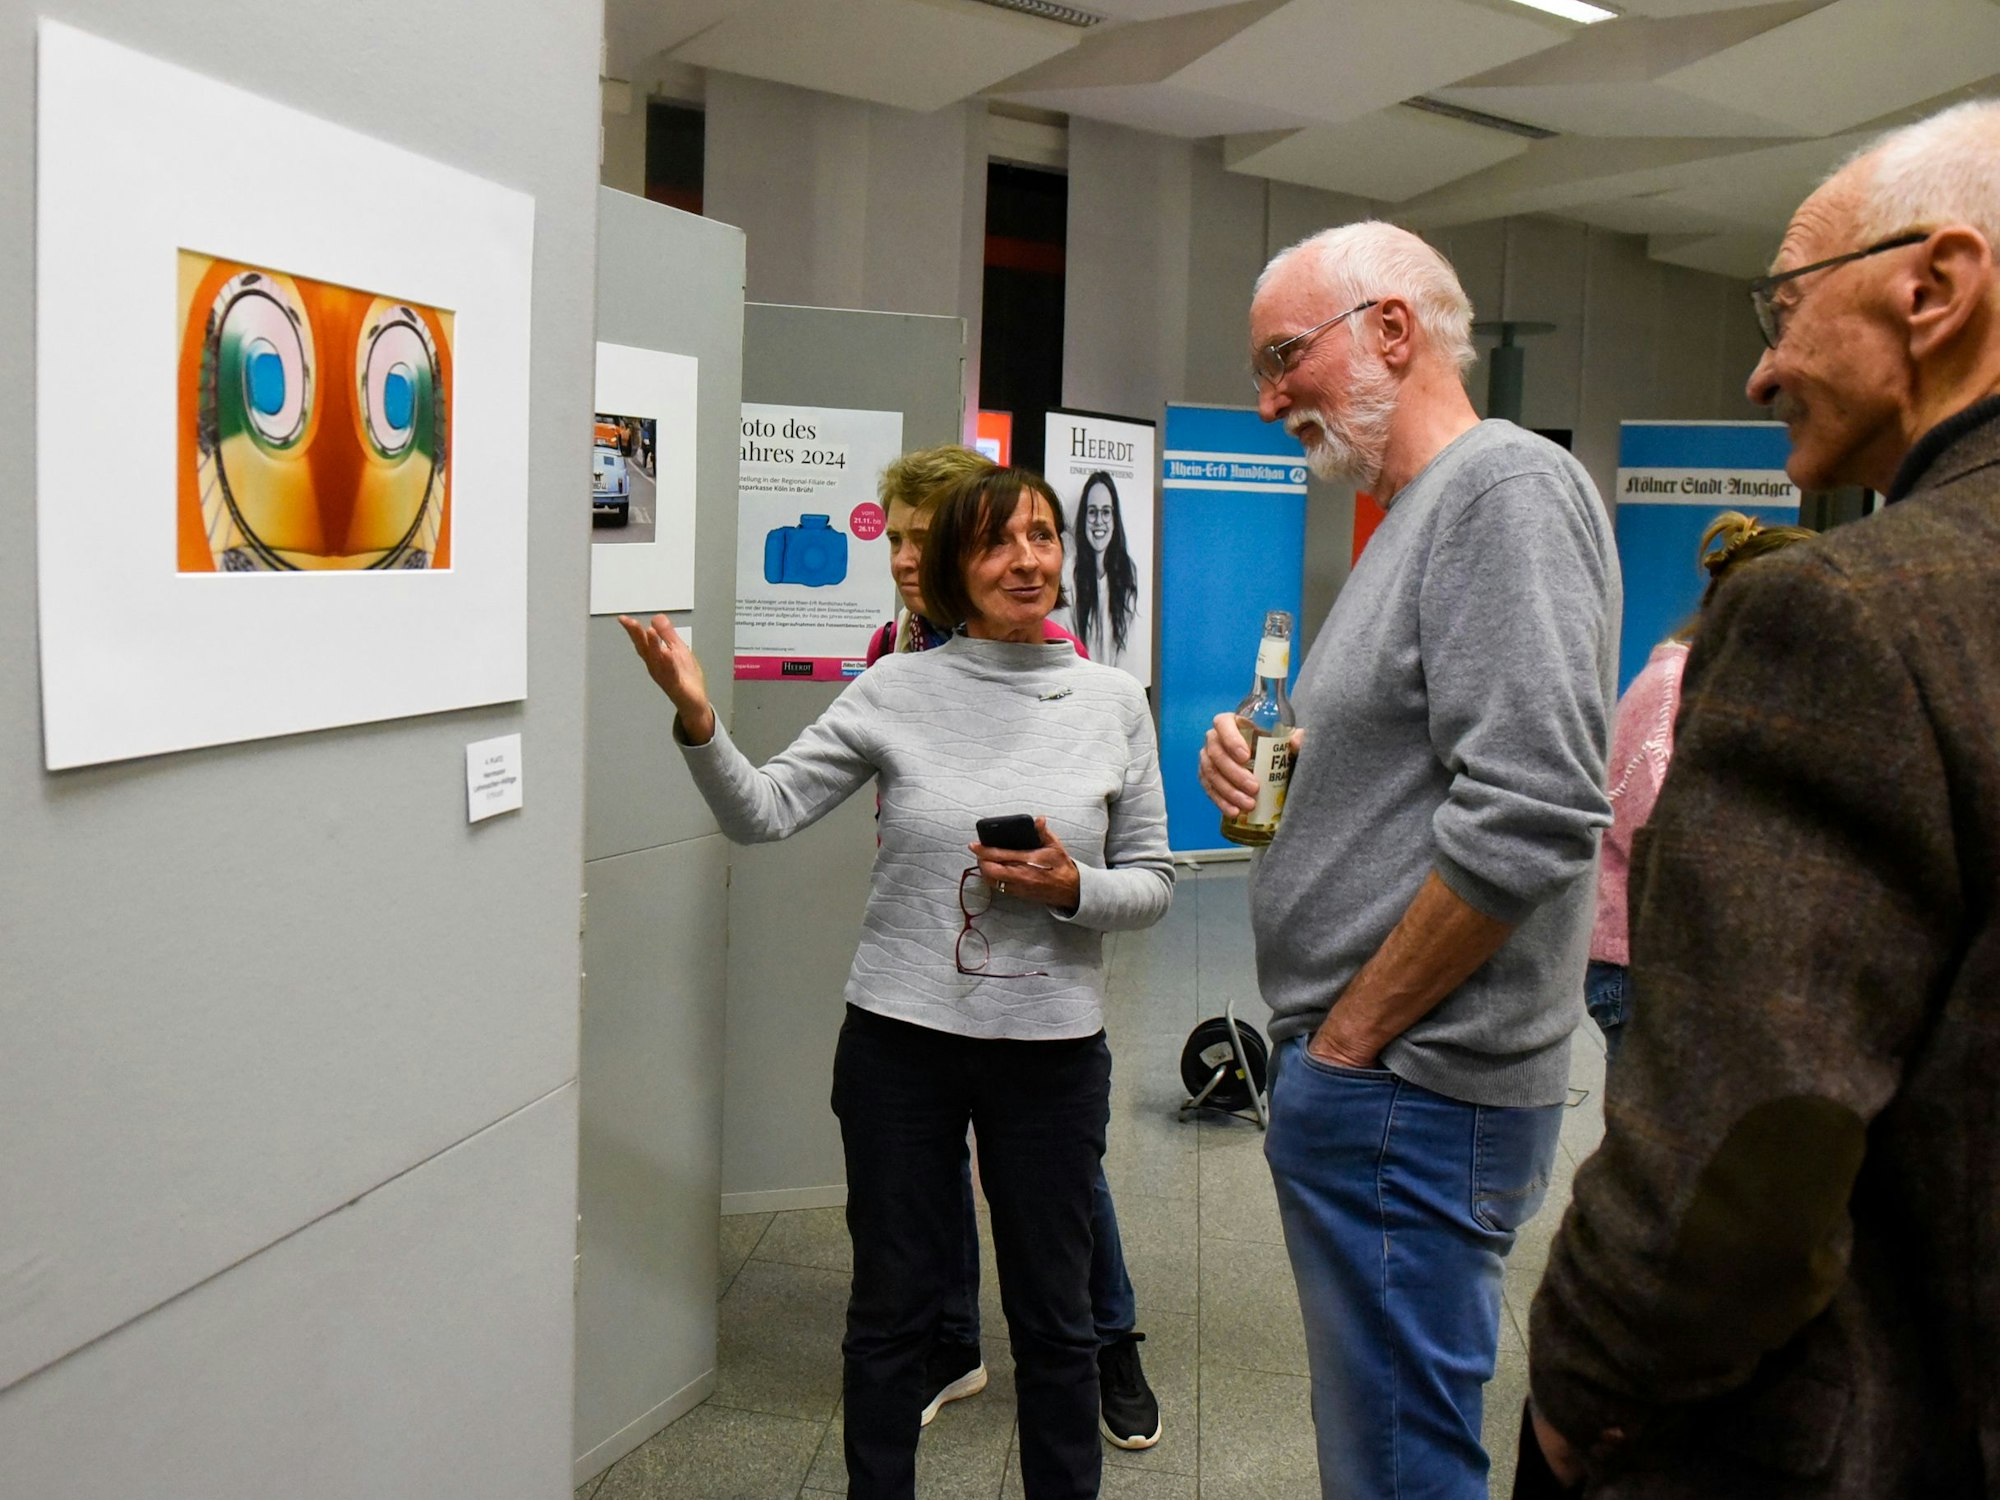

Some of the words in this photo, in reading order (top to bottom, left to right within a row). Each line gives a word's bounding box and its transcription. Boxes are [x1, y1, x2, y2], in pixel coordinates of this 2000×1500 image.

[741, 417, 775, 438] oto
[783, 418, 816, 440] des
[740, 441, 794, 463] ahres
[801, 450, 846, 469] 2024
[1071, 427, 1134, 462] HEERDT
[1626, 476, 1677, 493] Kölner
[1269, 772, 1288, 782] BRA
